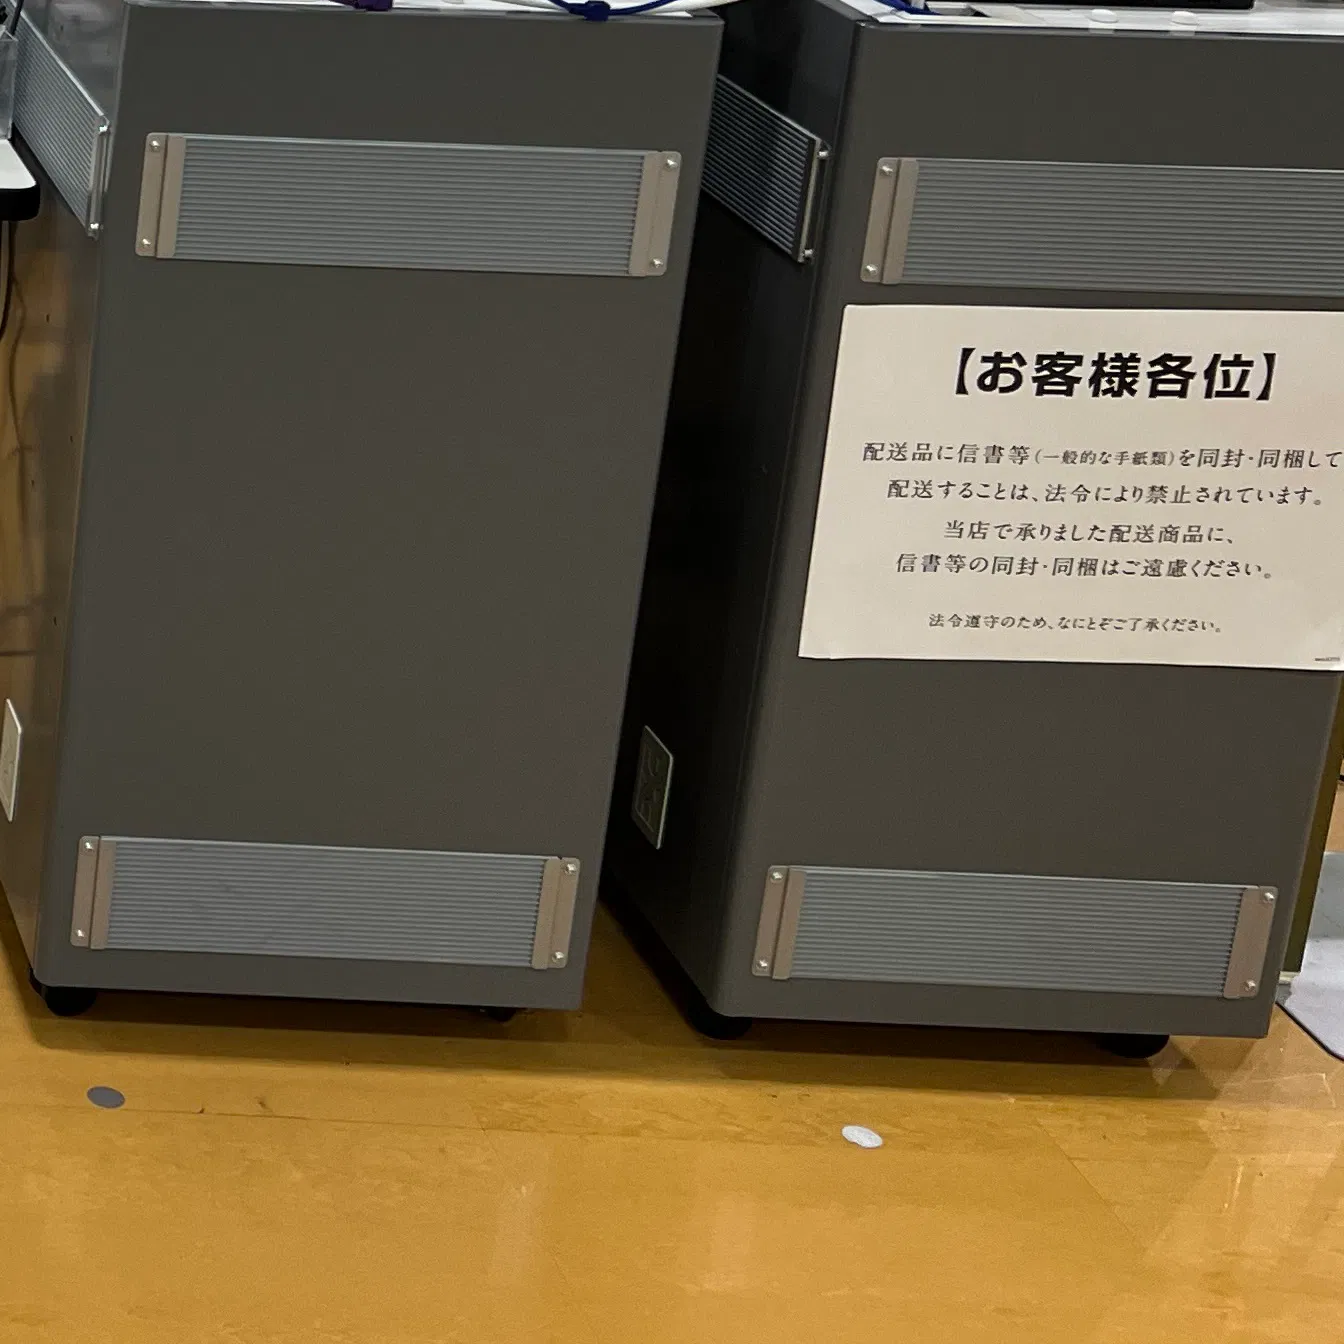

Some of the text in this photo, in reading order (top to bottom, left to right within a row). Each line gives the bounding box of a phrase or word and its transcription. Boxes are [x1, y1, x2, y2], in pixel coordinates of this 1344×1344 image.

[955, 347, 1277, 401] 【お客様各位】
[887, 479, 1323, 507] 配送することは、法令により禁止されています。
[944, 519, 1237, 544] 当店で承りました配送商品に、
